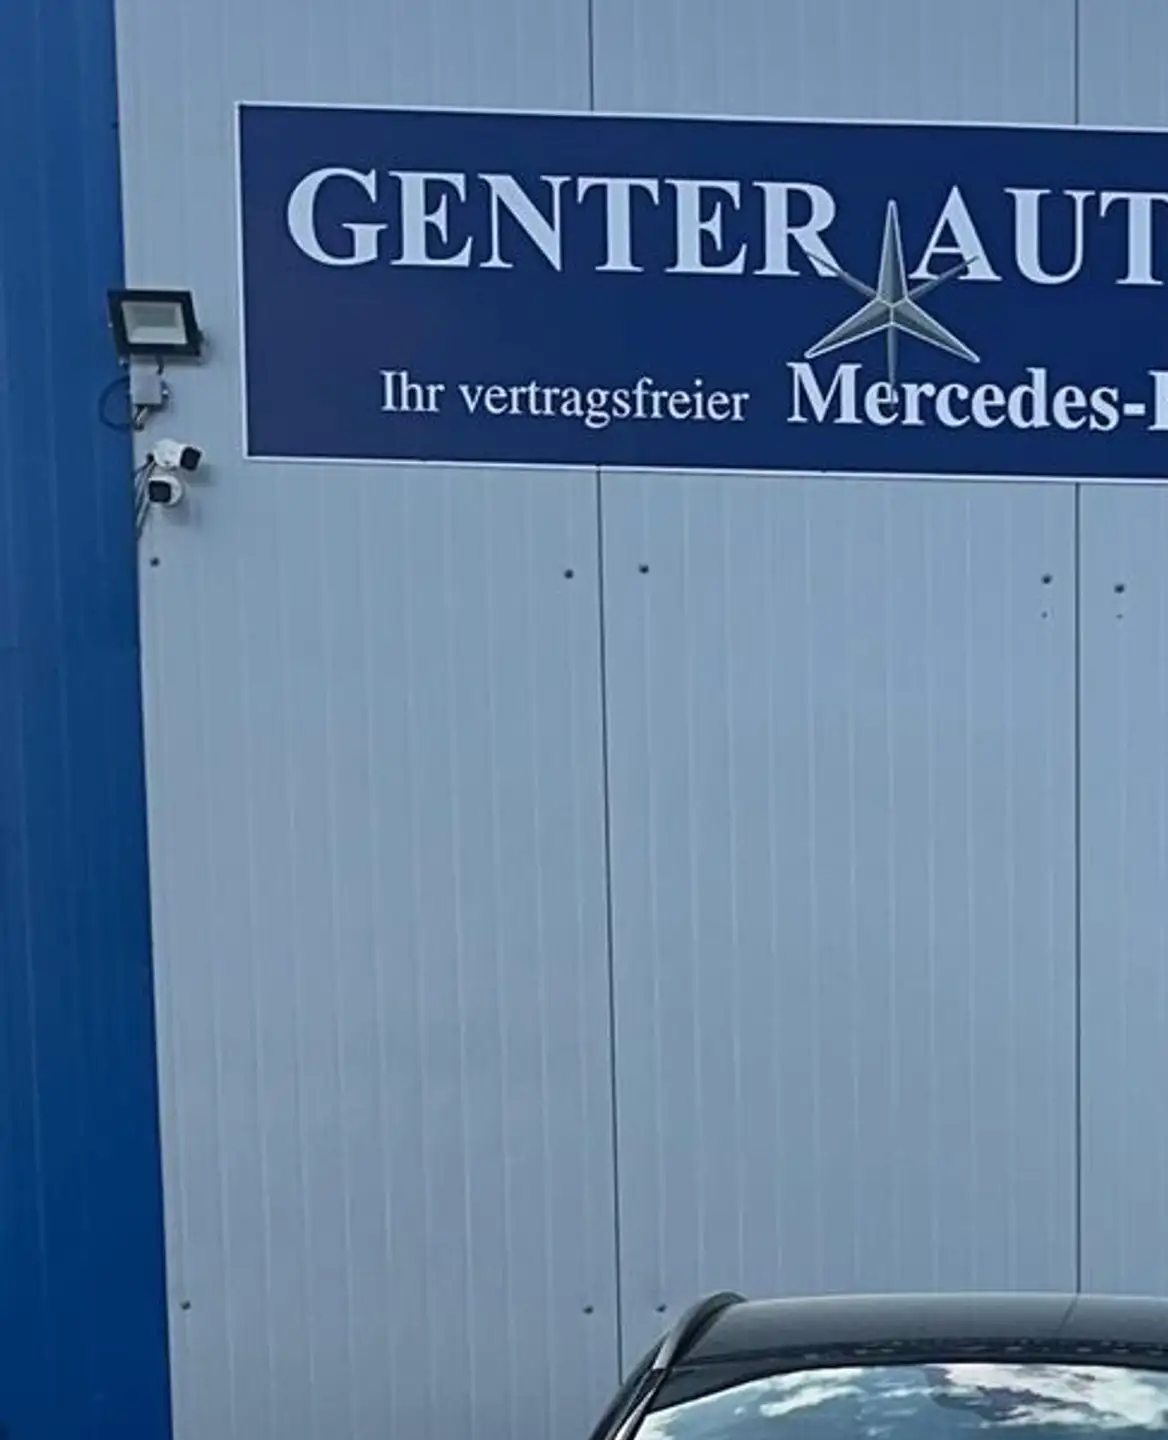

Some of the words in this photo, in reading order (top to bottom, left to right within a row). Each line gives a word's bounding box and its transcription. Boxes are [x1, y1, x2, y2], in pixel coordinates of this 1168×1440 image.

[286, 167, 842, 278] GENTER
[381, 370, 445, 412] Ihr
[460, 377, 750, 428] vertragsfreier
